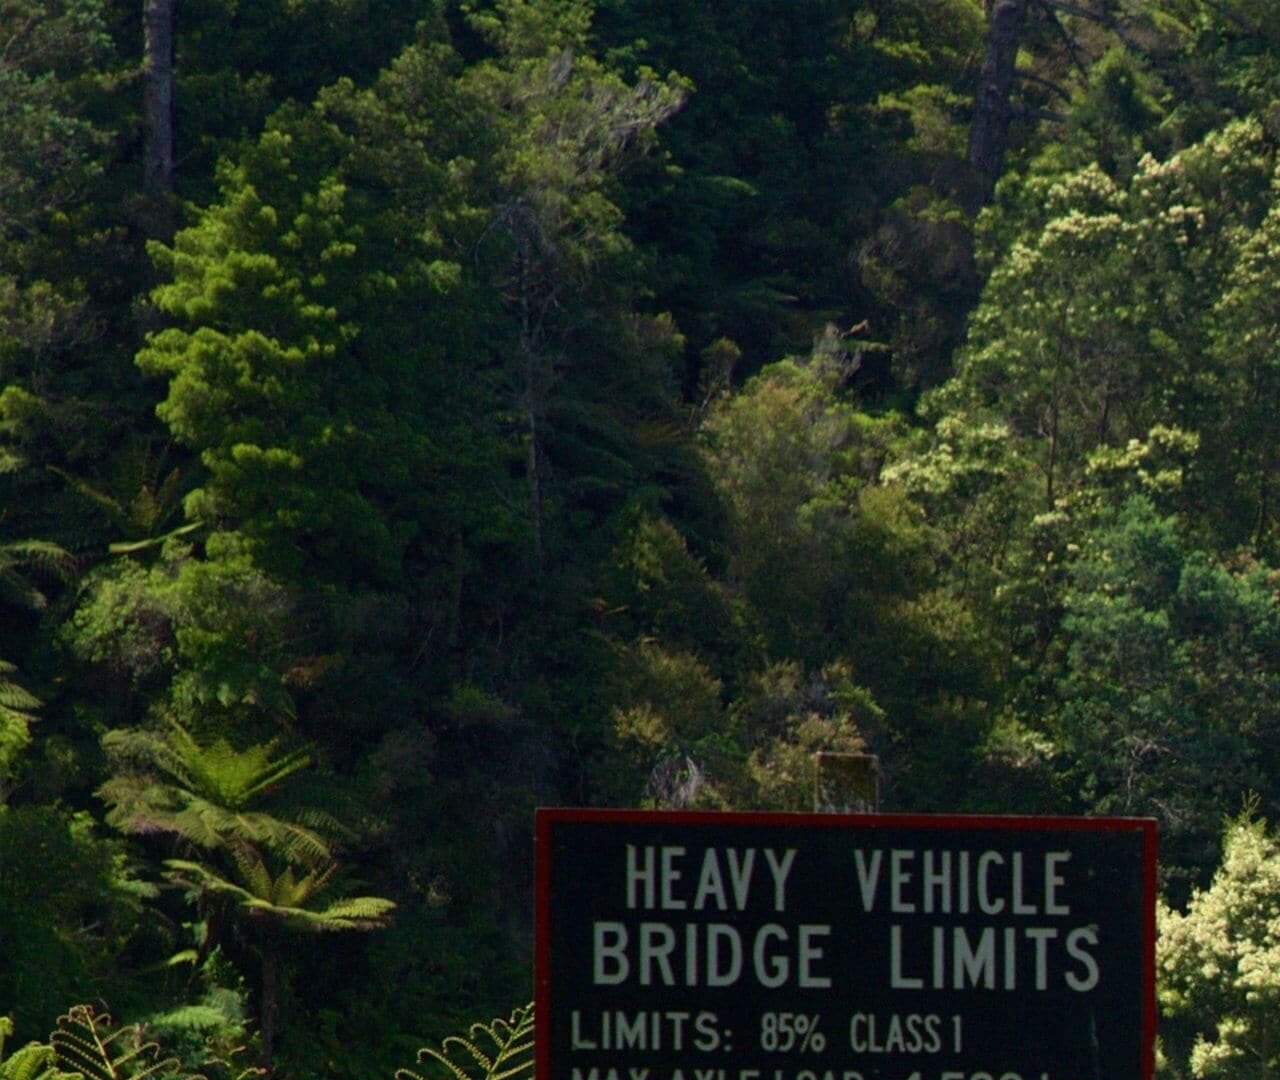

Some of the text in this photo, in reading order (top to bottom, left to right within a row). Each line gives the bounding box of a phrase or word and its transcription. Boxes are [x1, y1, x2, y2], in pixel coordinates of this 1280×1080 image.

[626, 844, 1072, 916] HEAVY VEHICLE
[593, 921, 1100, 992] BRIDGE LIMITS
[571, 1010, 733, 1052] LIMITS:
[760, 1011, 826, 1053] 85%
